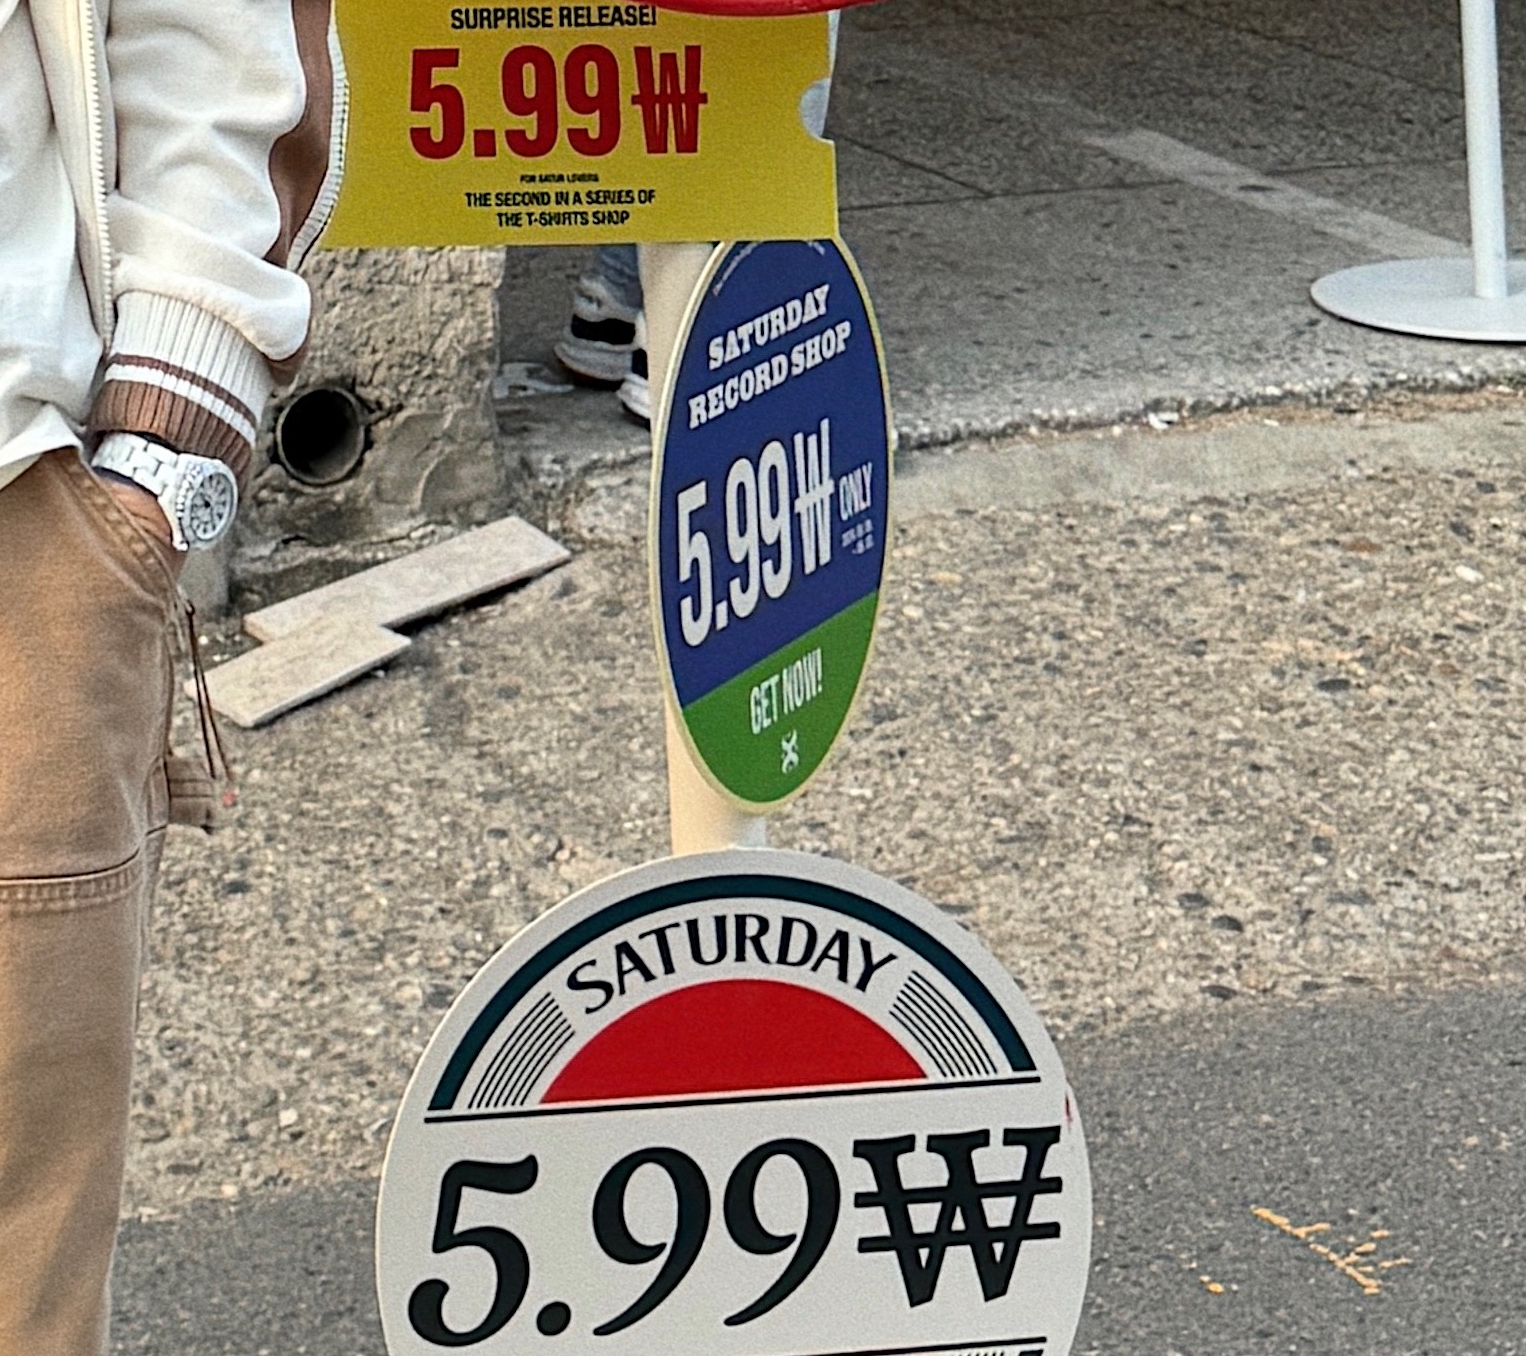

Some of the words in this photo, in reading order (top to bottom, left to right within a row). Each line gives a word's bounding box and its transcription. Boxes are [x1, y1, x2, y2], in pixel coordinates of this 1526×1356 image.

[451, 6, 553, 29] SURPRISE
[465, 192, 492, 207] THE
[495, 191, 551, 207] SECOND
[555, 191, 569, 206] IN
[572, 191, 583, 205] A
[586, 190, 635, 205] SERIES
[638, 189, 656, 204] OF
[496, 212, 523, 227] THE
[592, 210, 630, 225] SHOP
[707, 283, 830, 370] SATURDAY
[687, 352, 789, 429] RECORD
[790, 321, 853, 378] SHOP
[839, 461, 873, 522] ONLY
[749, 675, 779, 736] GET
[781, 647, 824, 717] NOW!
[566, 913, 898, 1016] SATURDAY
